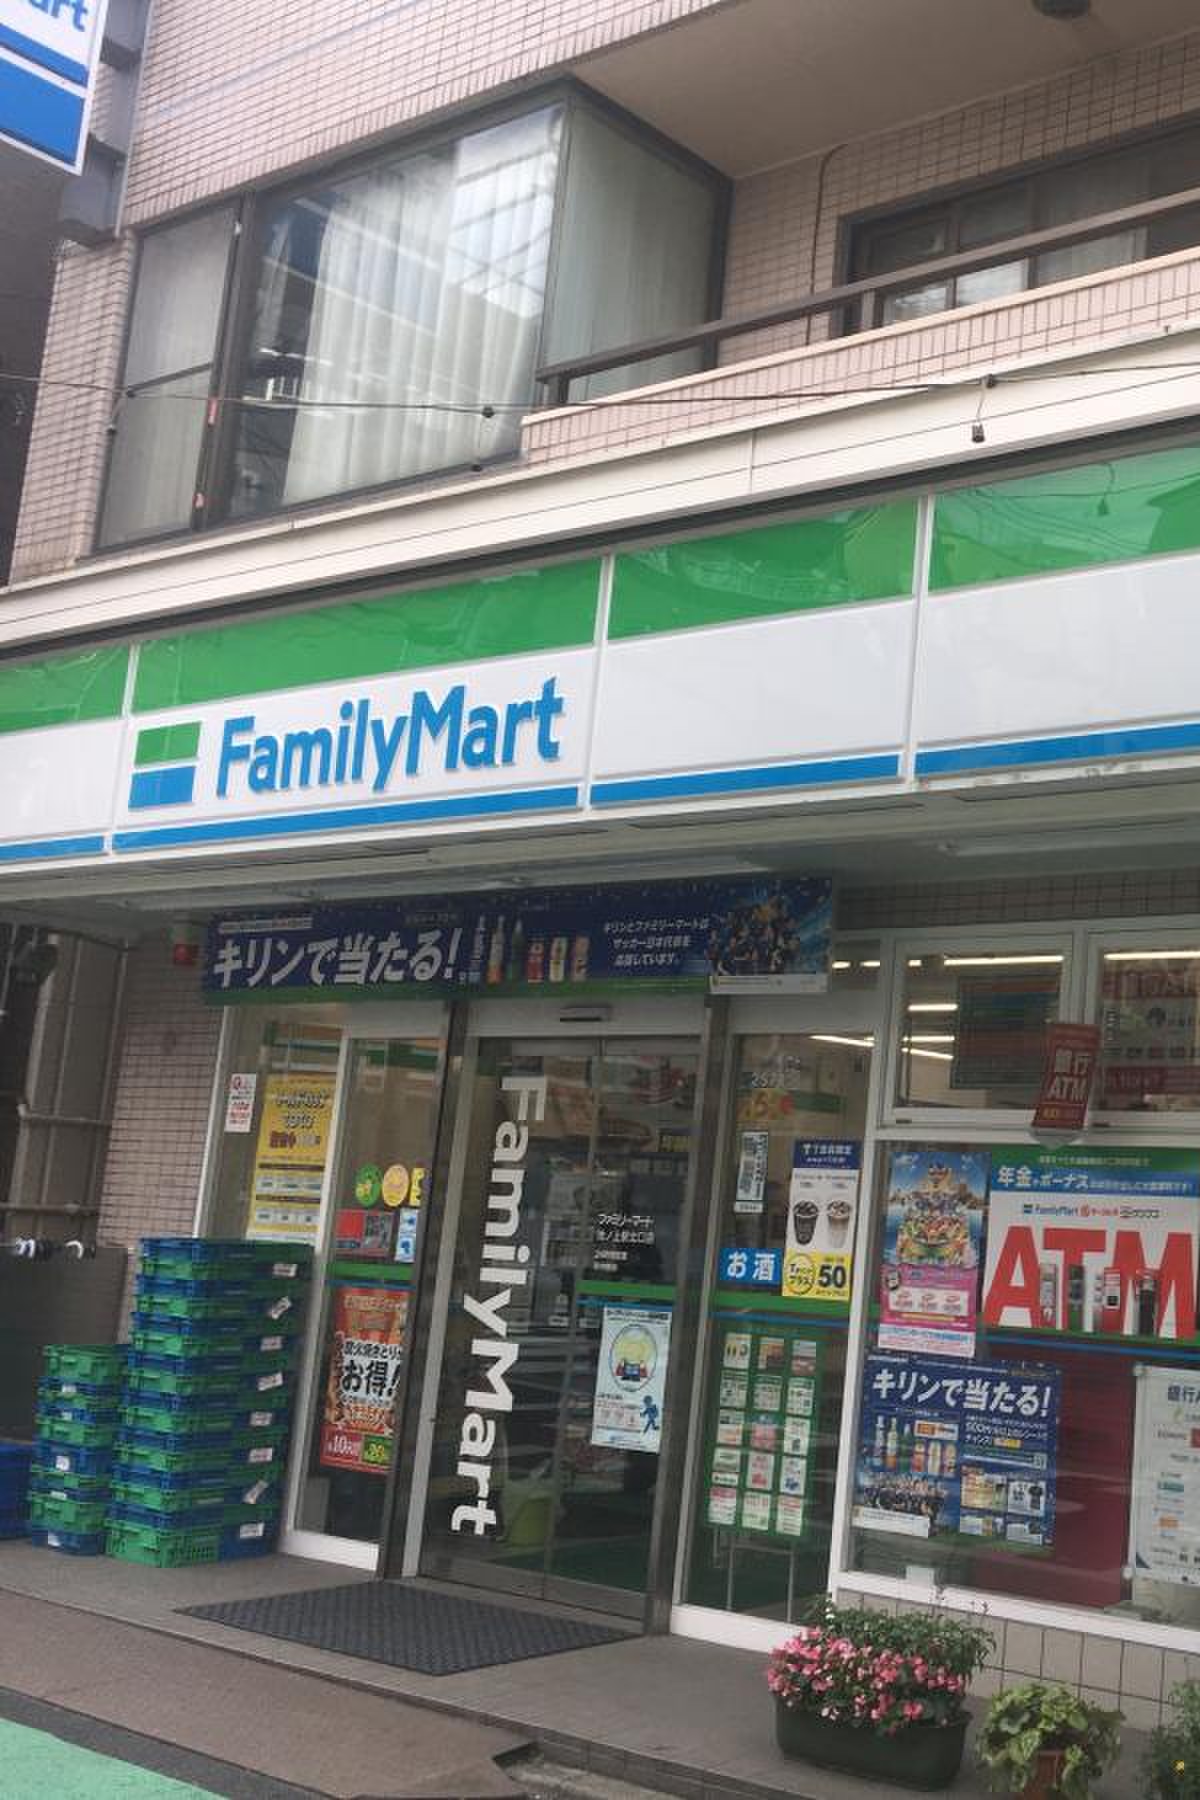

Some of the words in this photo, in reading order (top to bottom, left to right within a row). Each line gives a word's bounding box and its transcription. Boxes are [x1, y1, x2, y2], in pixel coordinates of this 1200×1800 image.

[216, 676, 564, 798] FamilyMart
[451, 1075, 547, 1536] FamilyMart
[727, 1251, 775, 1281] お酒
[818, 1264, 847, 1289] 50
[982, 1225, 1198, 1339] ATM
[873, 1369, 1050, 1418] キリンで当たる!
